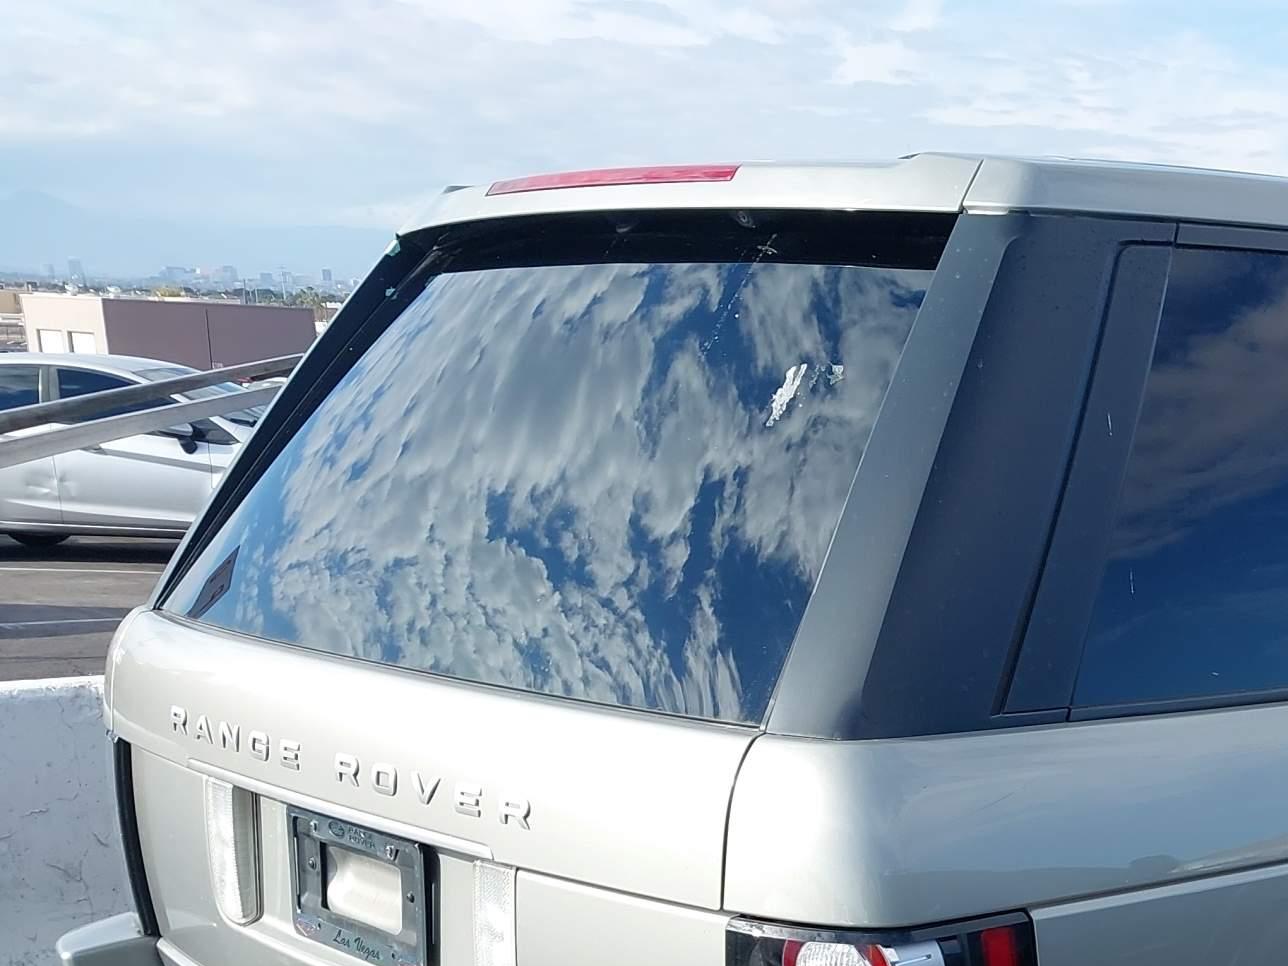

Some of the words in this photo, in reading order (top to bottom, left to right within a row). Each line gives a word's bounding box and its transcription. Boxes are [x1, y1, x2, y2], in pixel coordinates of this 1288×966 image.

[171, 705, 302, 771] RANGE
[334, 752, 532, 830] ROVER
[333, 929, 351, 949] Las
[354, 936, 381, 961] Vegas
